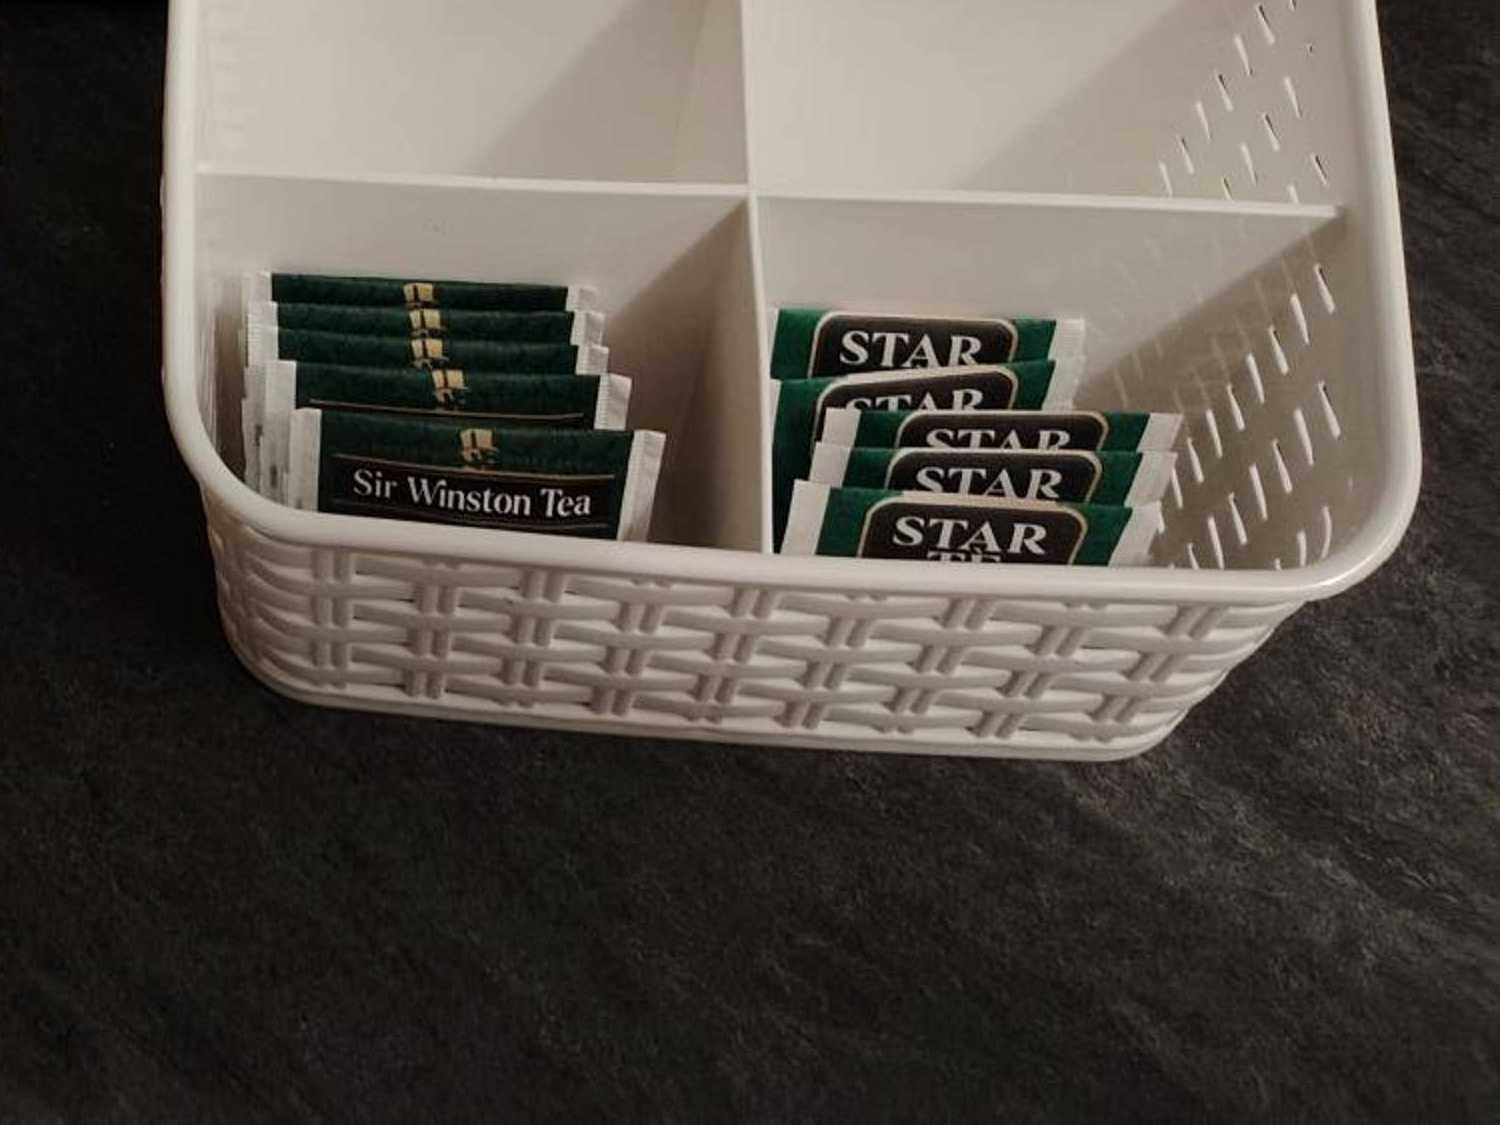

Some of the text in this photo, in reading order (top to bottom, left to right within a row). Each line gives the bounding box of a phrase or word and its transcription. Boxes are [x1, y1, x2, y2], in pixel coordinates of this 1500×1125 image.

[839, 330, 982, 368] STAR
[353, 468, 591, 518] Sir Winston Tea
[916, 466, 1062, 499] STAR
[893, 515, 1047, 555] STAR
